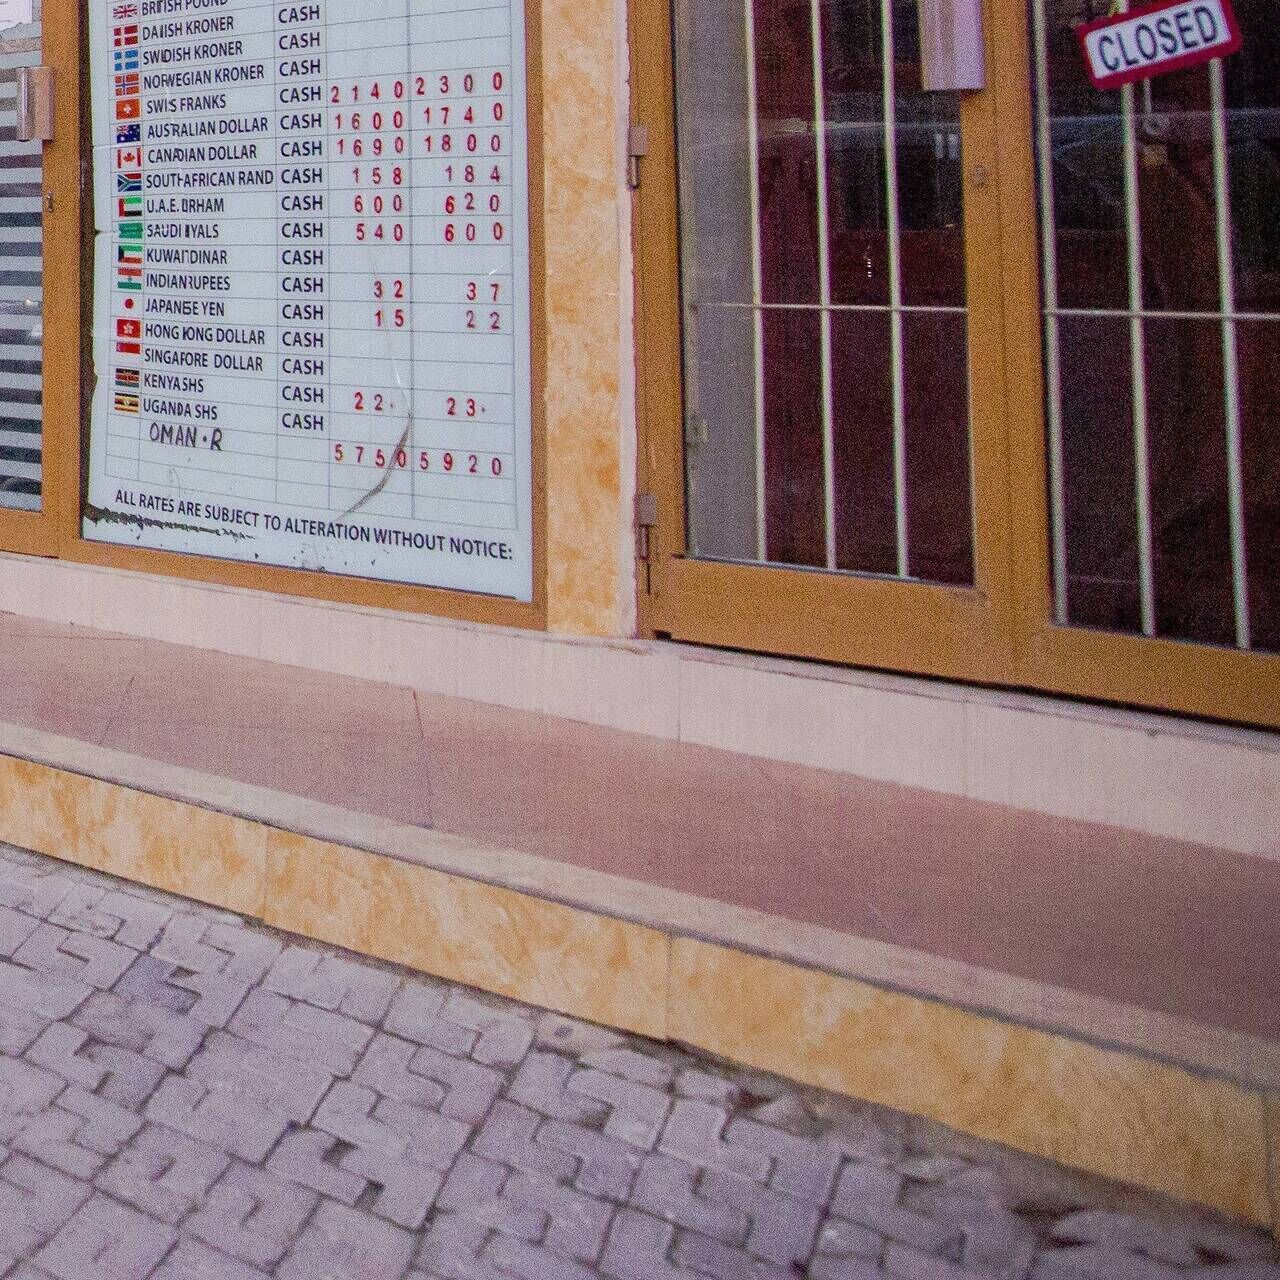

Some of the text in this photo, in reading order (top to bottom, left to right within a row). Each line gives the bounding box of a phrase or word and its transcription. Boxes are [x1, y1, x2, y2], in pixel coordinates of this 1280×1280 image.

[186, 5, 320, 34] KRONER CASH
[195, 32, 320, 59] KRONER CASH
[1098, 5, 1219, 72] CLOSED
[215, 59, 321, 83] KRONER CASH
[180, 94, 226, 112] FRANKS
[280, 86, 321, 104] CASH
[219, 117, 268, 135] DOLLAR
[280, 114, 322, 130] CASH
[208, 144, 257, 161] DOLLAR
[280, 141, 322, 157] CASH
[184, 168, 323, 187] AFRICAN RAND CASH
[147, 195, 323, 213] U.A.E. CASH
[147, 223, 323, 238] SAUDI CASH
[191, 250, 324, 265] DINAR CASH
[146, 274, 324, 293] INDIAN CASH
[201, 301, 324, 320] YEN CASH
[145, 324, 324, 348] HONG DOLLAR CASH
[214, 354, 324, 375] DOLLAR CASH
[143, 399, 324, 431] UGANDA SHS CASH
[149, 422, 197, 448] OMAN
[115, 489, 513, 560] ALL RATES ARE SUBJECT TO ALTERATION WITHOUT NOTICE:
